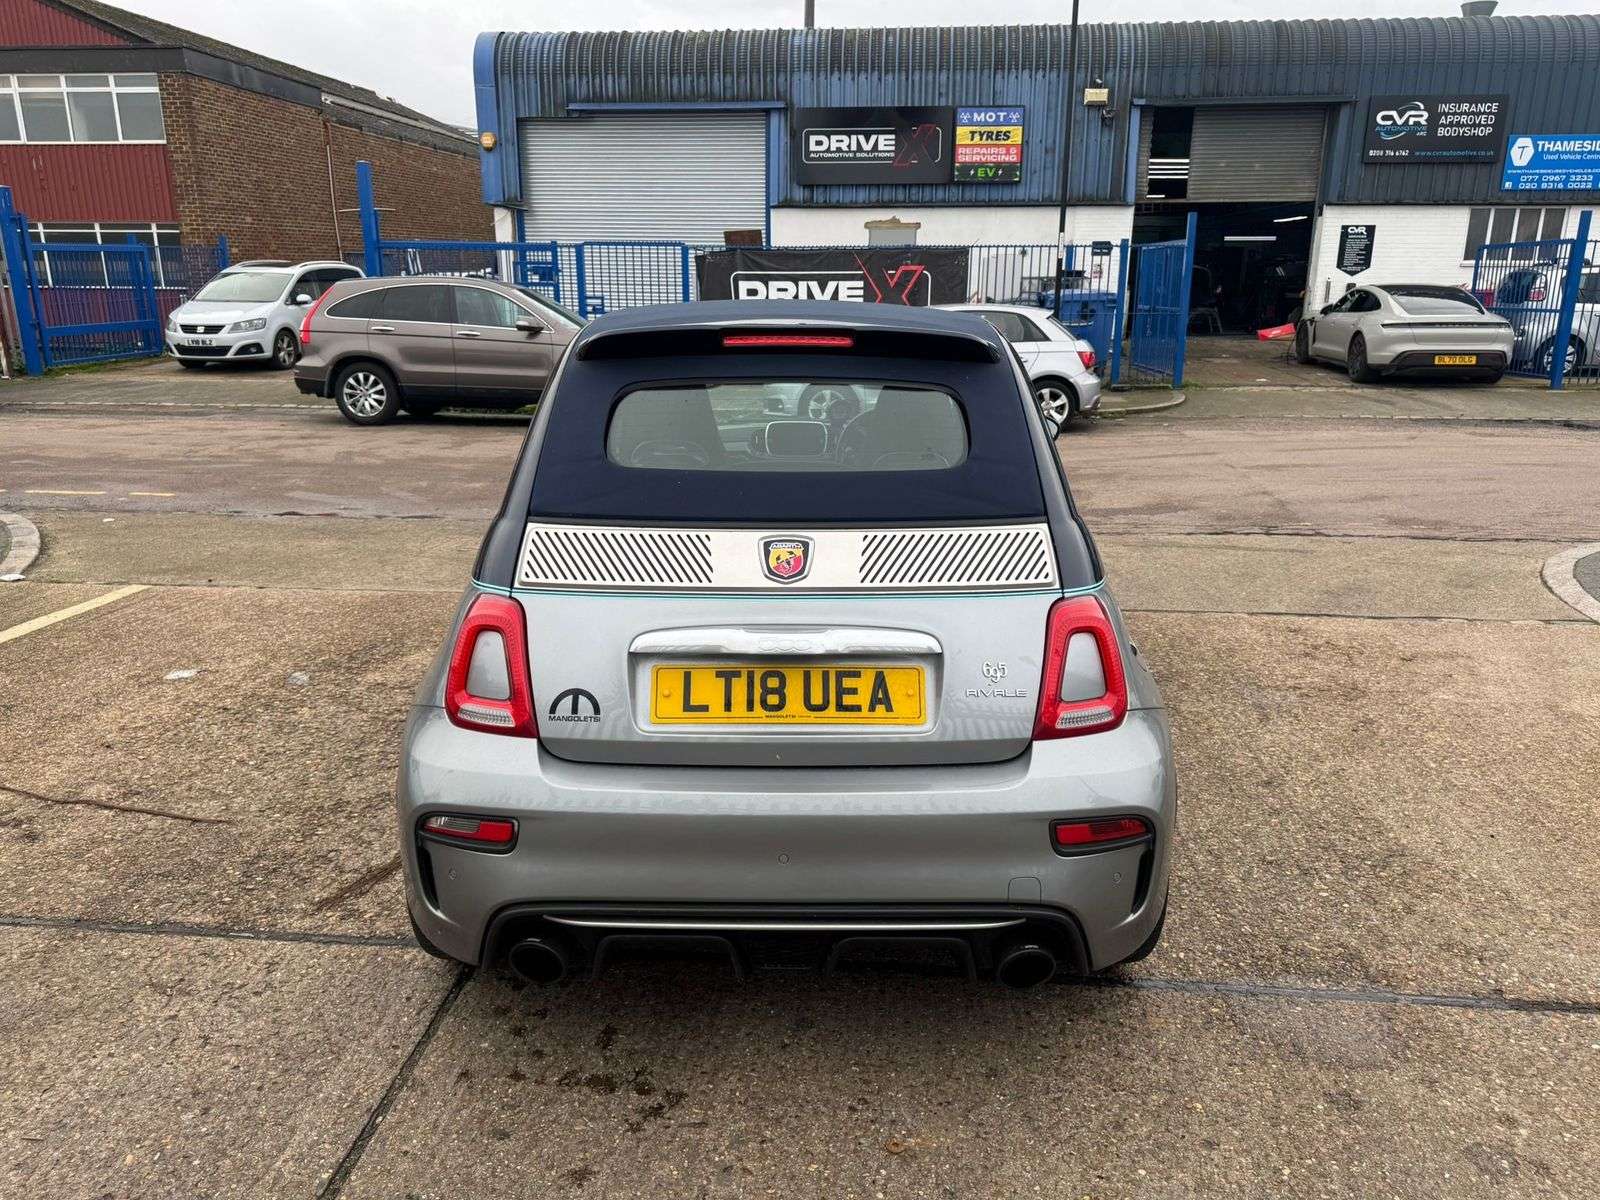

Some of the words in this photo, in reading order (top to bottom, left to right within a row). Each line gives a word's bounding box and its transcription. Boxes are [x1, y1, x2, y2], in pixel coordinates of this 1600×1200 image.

[1438, 102, 1500, 113] INSURANCE
[973, 111, 1007, 122] MOT
[1376, 110, 1429, 126] CVR
[1438, 115, 1496, 125] APPROVED
[969, 130, 1012, 142] TYRES
[1437, 127, 1493, 137] BODYSHOP
[808, 134, 896, 152] DRIVE
[958, 154, 1017, 162] SERVICING
[977, 167, 996, 177] EV
[738, 281, 864, 302] DRIVE
[982, 661, 1008, 683] 695
[682, 670, 787, 713] LT18
[802, 670, 894, 713] UEA
[965, 688, 1028, 698] RIVALE
